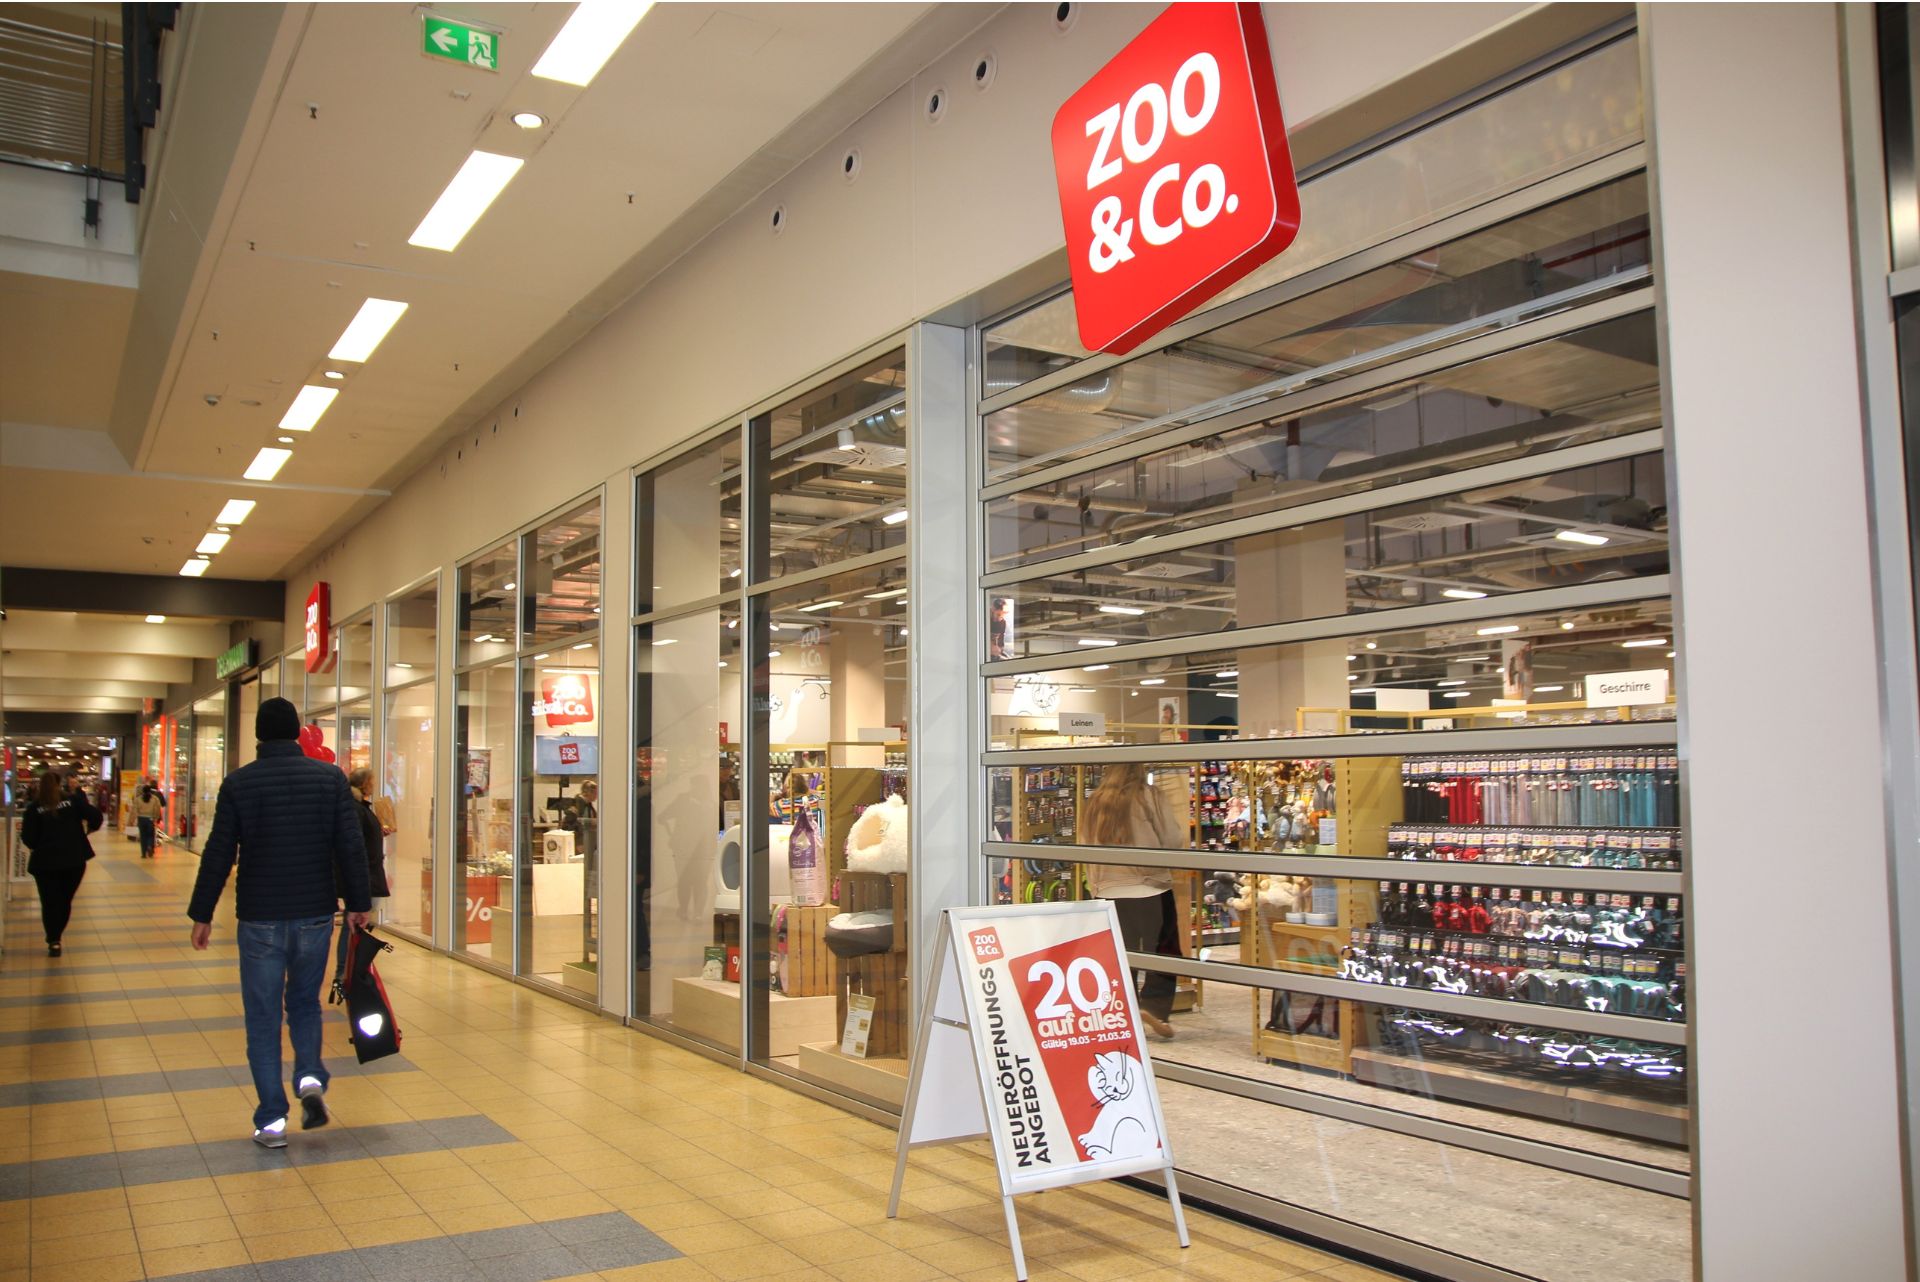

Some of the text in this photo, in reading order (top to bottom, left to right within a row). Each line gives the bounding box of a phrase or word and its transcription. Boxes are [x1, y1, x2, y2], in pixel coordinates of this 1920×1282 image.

[1085, 52, 1220, 190] ZOO
[1088, 163, 1239, 273] &Co.
[1600, 682, 1651, 693] Geschirre
[975, 934, 996, 945] ZOO
[1038, 1008, 1128, 1037] auf alles
[1041, 1038, 1068, 1049] Gültig
[981, 966, 1033, 1168] NEUERÖFFNUNGS
[1015, 1054, 1052, 1164] ANGEBOT
